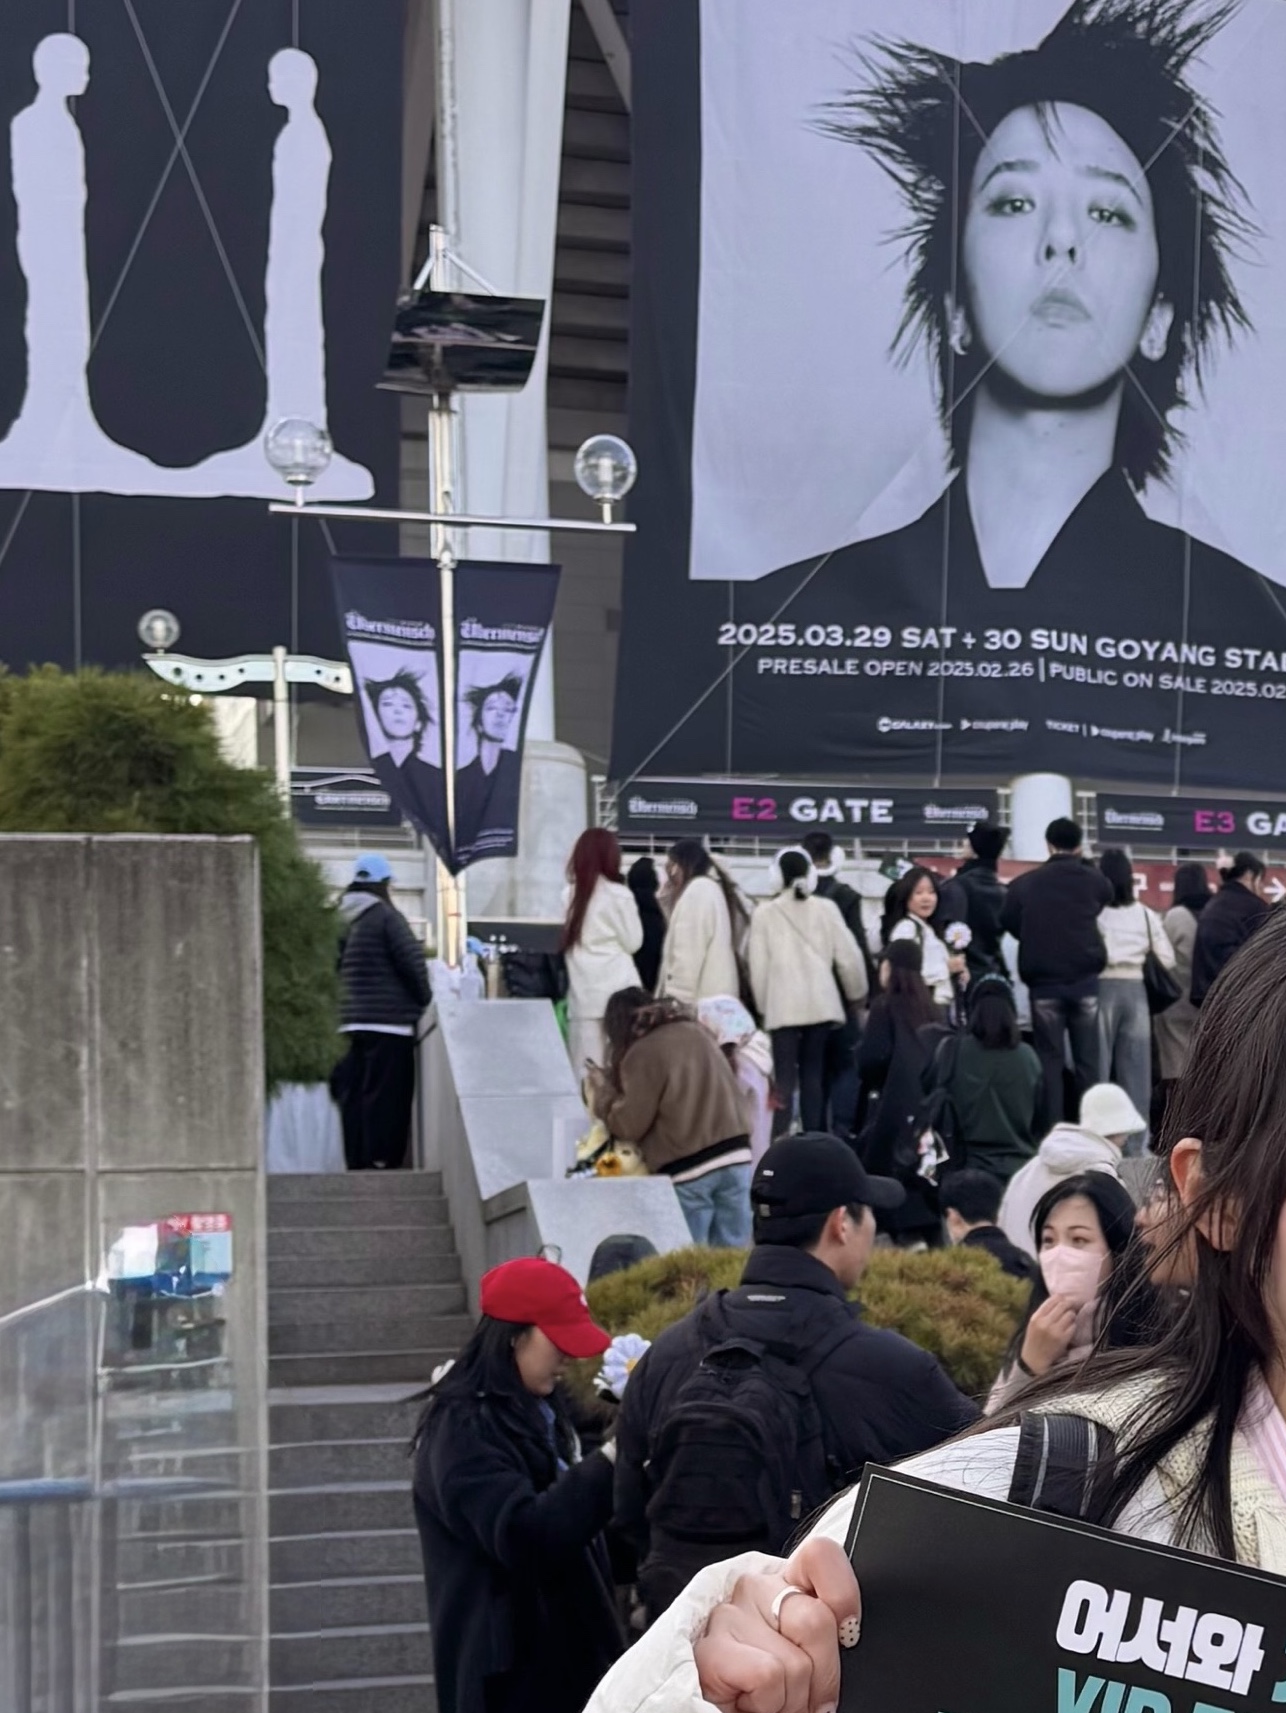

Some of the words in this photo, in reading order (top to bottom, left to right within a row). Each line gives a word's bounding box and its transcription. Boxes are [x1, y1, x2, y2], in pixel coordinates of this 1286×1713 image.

[717, 623, 892, 647] 2025.03.29
[901, 627, 957, 649] SAT
[983, 629, 1022, 650] 30
[1030, 629, 1087, 656] SUN
[1095, 637, 1216, 668] GOYANG
[757, 657, 860, 676] PRESALE
[863, 659, 923, 677] OPEN
[926, 661, 1035, 678] 2025.02.26
[1049, 662, 1118, 686] PUBLIC
[1122, 671, 1153, 689] ON
[1158, 674, 1207, 694] SALE
[731, 797, 778, 821] E2
[789, 798, 894, 823] GATE
[1194, 809, 1236, 833] E3
[1055, 1579, 1264, 1695] 어서와
